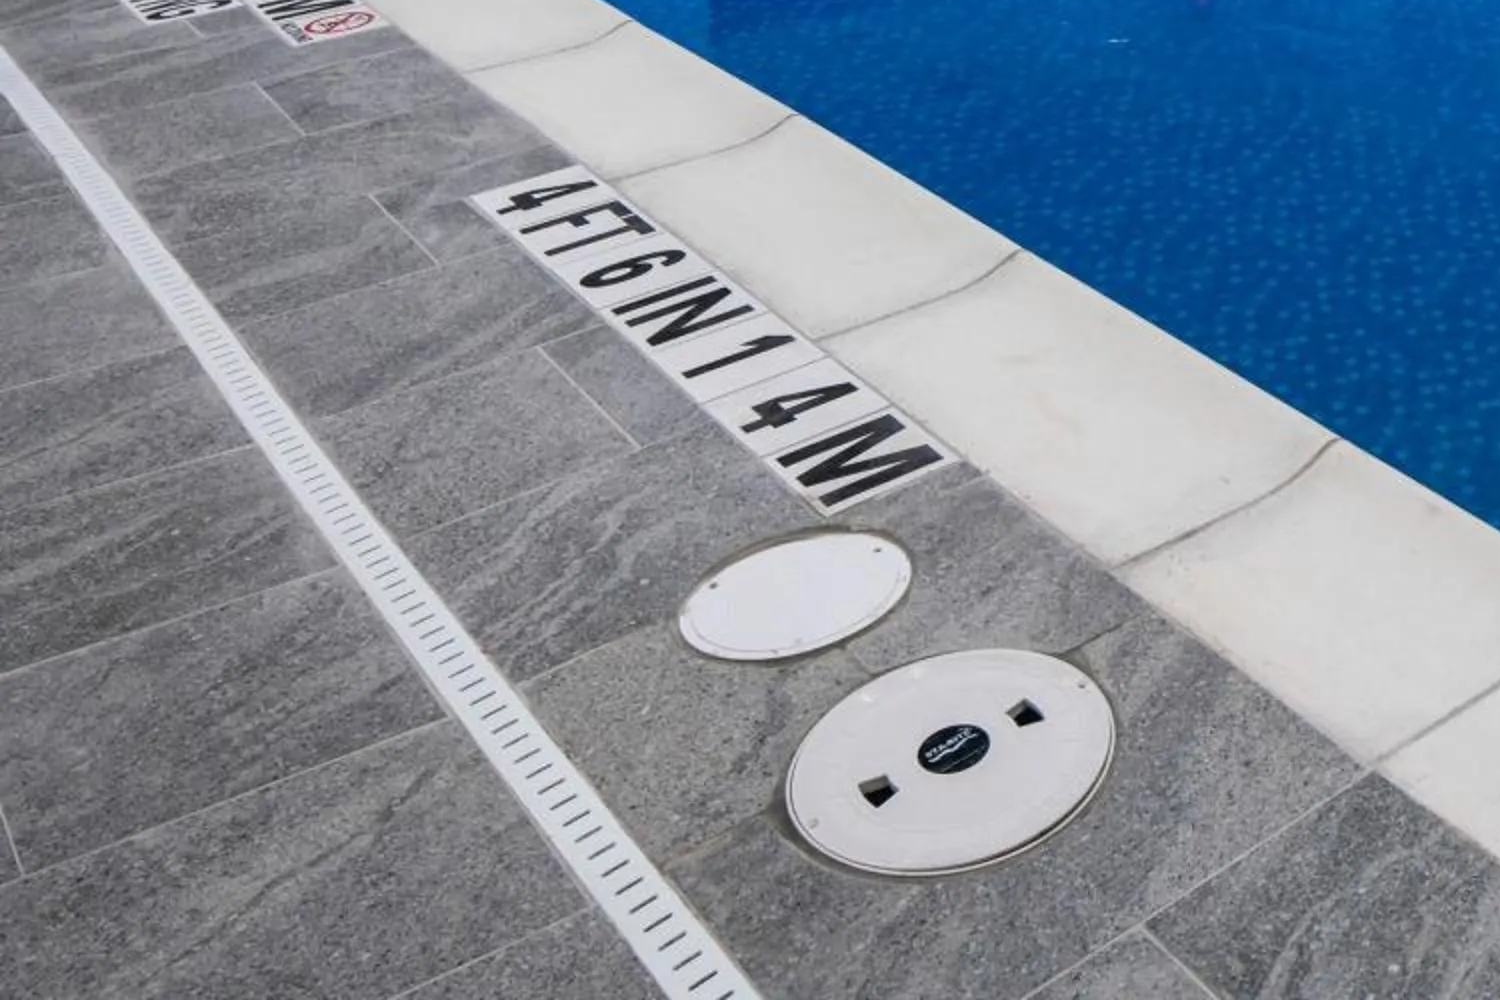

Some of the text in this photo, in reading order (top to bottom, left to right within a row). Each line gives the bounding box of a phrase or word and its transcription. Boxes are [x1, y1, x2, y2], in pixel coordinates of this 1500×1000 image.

[496, 179, 945, 507] 4 FT 6 IN 1 4 M
